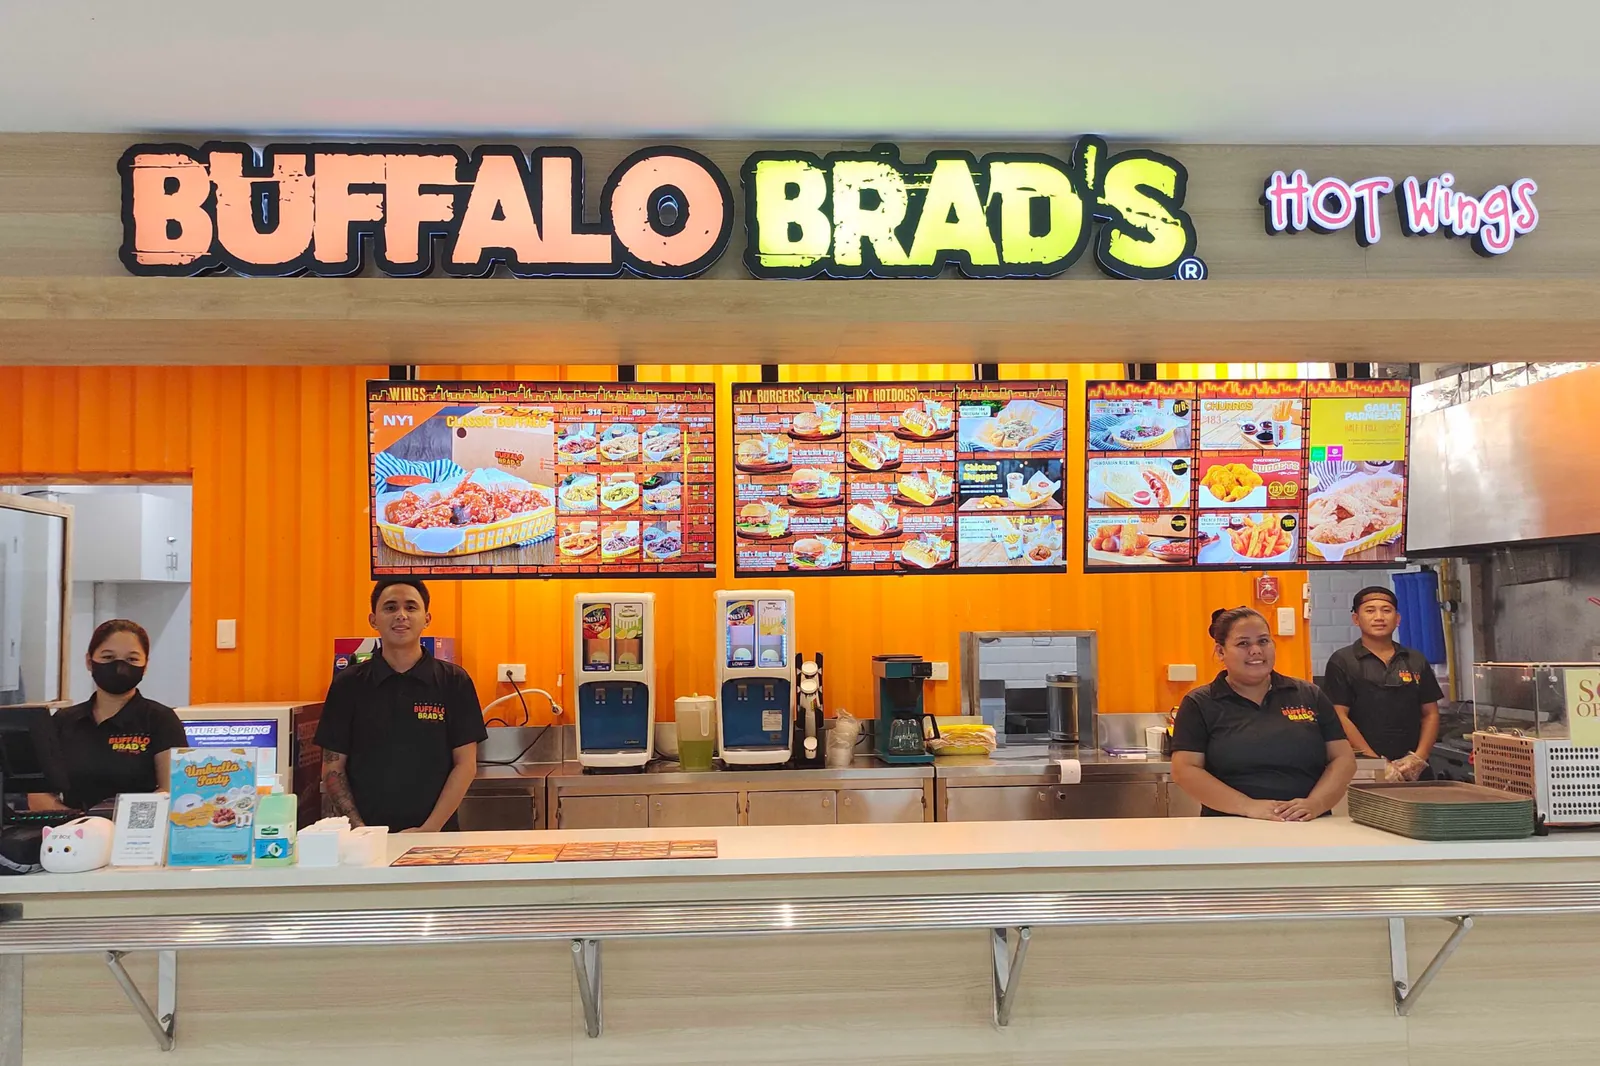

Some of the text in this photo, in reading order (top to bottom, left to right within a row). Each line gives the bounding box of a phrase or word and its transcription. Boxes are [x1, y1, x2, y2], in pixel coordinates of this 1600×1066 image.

[125, 148, 730, 269] BUFFALO
[752, 143, 1188, 270] BRAD'S
[1264, 170, 1539, 254] HOT Wings
[389, 387, 426, 401] WINGS
[740, 389, 801, 403] NY BURGERS
[856, 388, 916, 402] NY HOTDOGS
[1204, 401, 1253, 411] CHURROS
[1364, 403, 1402, 412] GARLIC
[383, 415, 414, 426] NY1
[446, 416, 494, 428] CLASSIC
[497, 415, 548, 428] BUFFALO
[964, 463, 997, 472] Chicken
[1252, 461, 1300, 473] NUGGETS
[963, 472, 998, 483] Nuggets
[1579, 679, 1600, 703] S
[230, 725, 271, 735] SPRING
[109, 736, 150, 744] BUFFALO
[185, 760, 240, 778] Umbrella
[196, 773, 231, 787] Party
